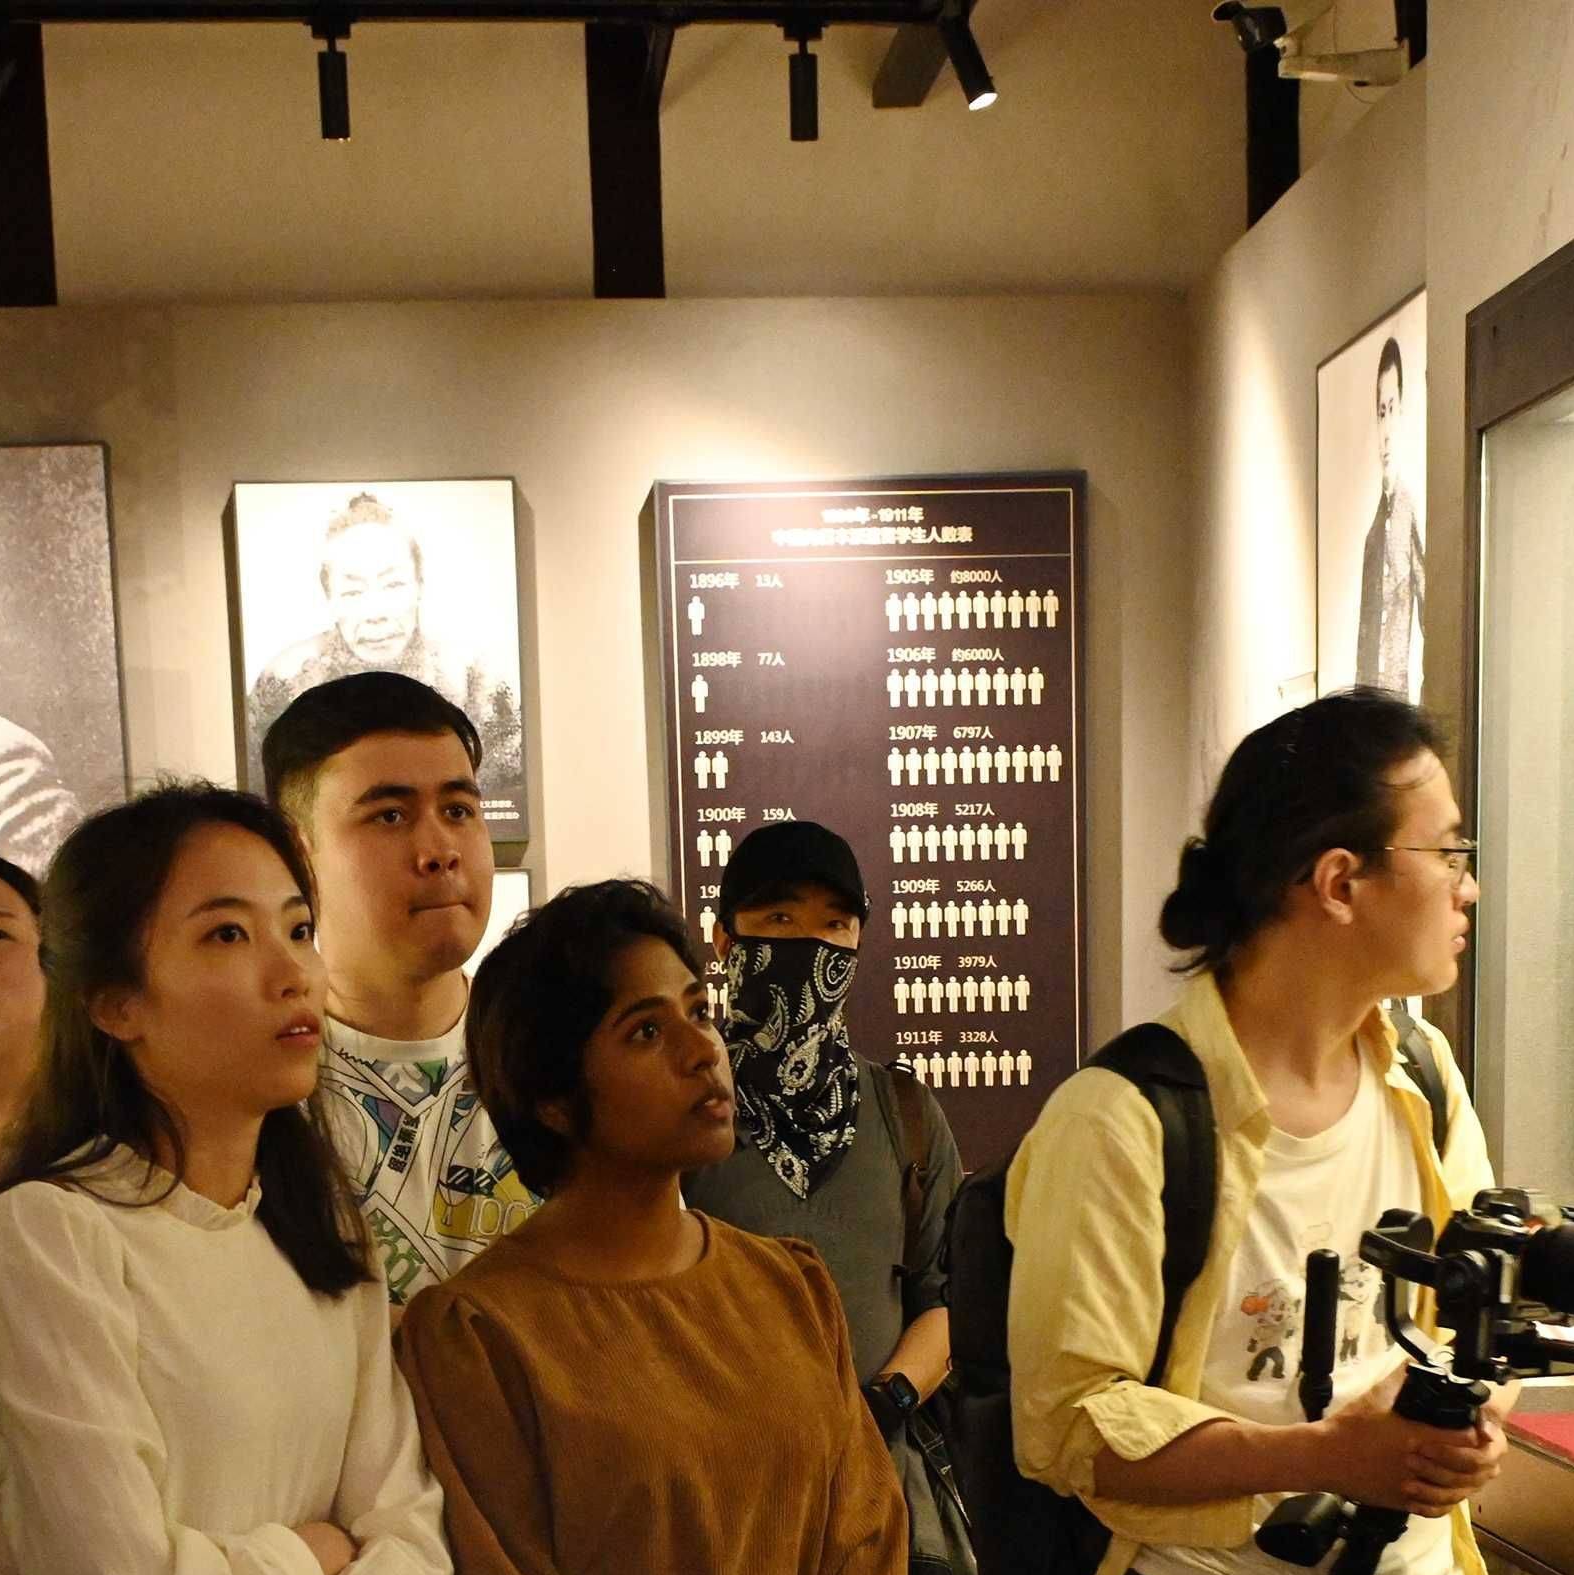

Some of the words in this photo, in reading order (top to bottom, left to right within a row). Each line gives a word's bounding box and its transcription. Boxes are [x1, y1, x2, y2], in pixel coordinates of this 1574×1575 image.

[689, 572, 740, 589] 1896年
[755, 573, 783, 588] 13人
[885, 568, 935, 585] 1905年
[950, 569, 1003, 584] 约8000人
[692, 650, 742, 668] 1898年
[757, 652, 785, 666] 77人
[887, 646, 936, 663] 1906年
[951, 648, 1004, 662] 约6000人
[694, 729, 744, 745] 1899年
[760, 730, 795, 743] 143人
[888, 724, 938, 741] 1907年
[953, 725, 994, 739] 6797人
[697, 806, 746, 823] 1900年
[762, 807, 797, 821] 159人
[890, 801, 939, 818] 1908年
[954, 803, 995, 816] 5217人
[892, 878, 940, 894] 1909年
[956, 879, 996, 893] 5266人
[893, 954, 942, 970] 1910年
[957, 955, 998, 968] 3979人
[895, 1030, 943, 1045] 1911年
[959, 1030, 999, 1043] 3328人
